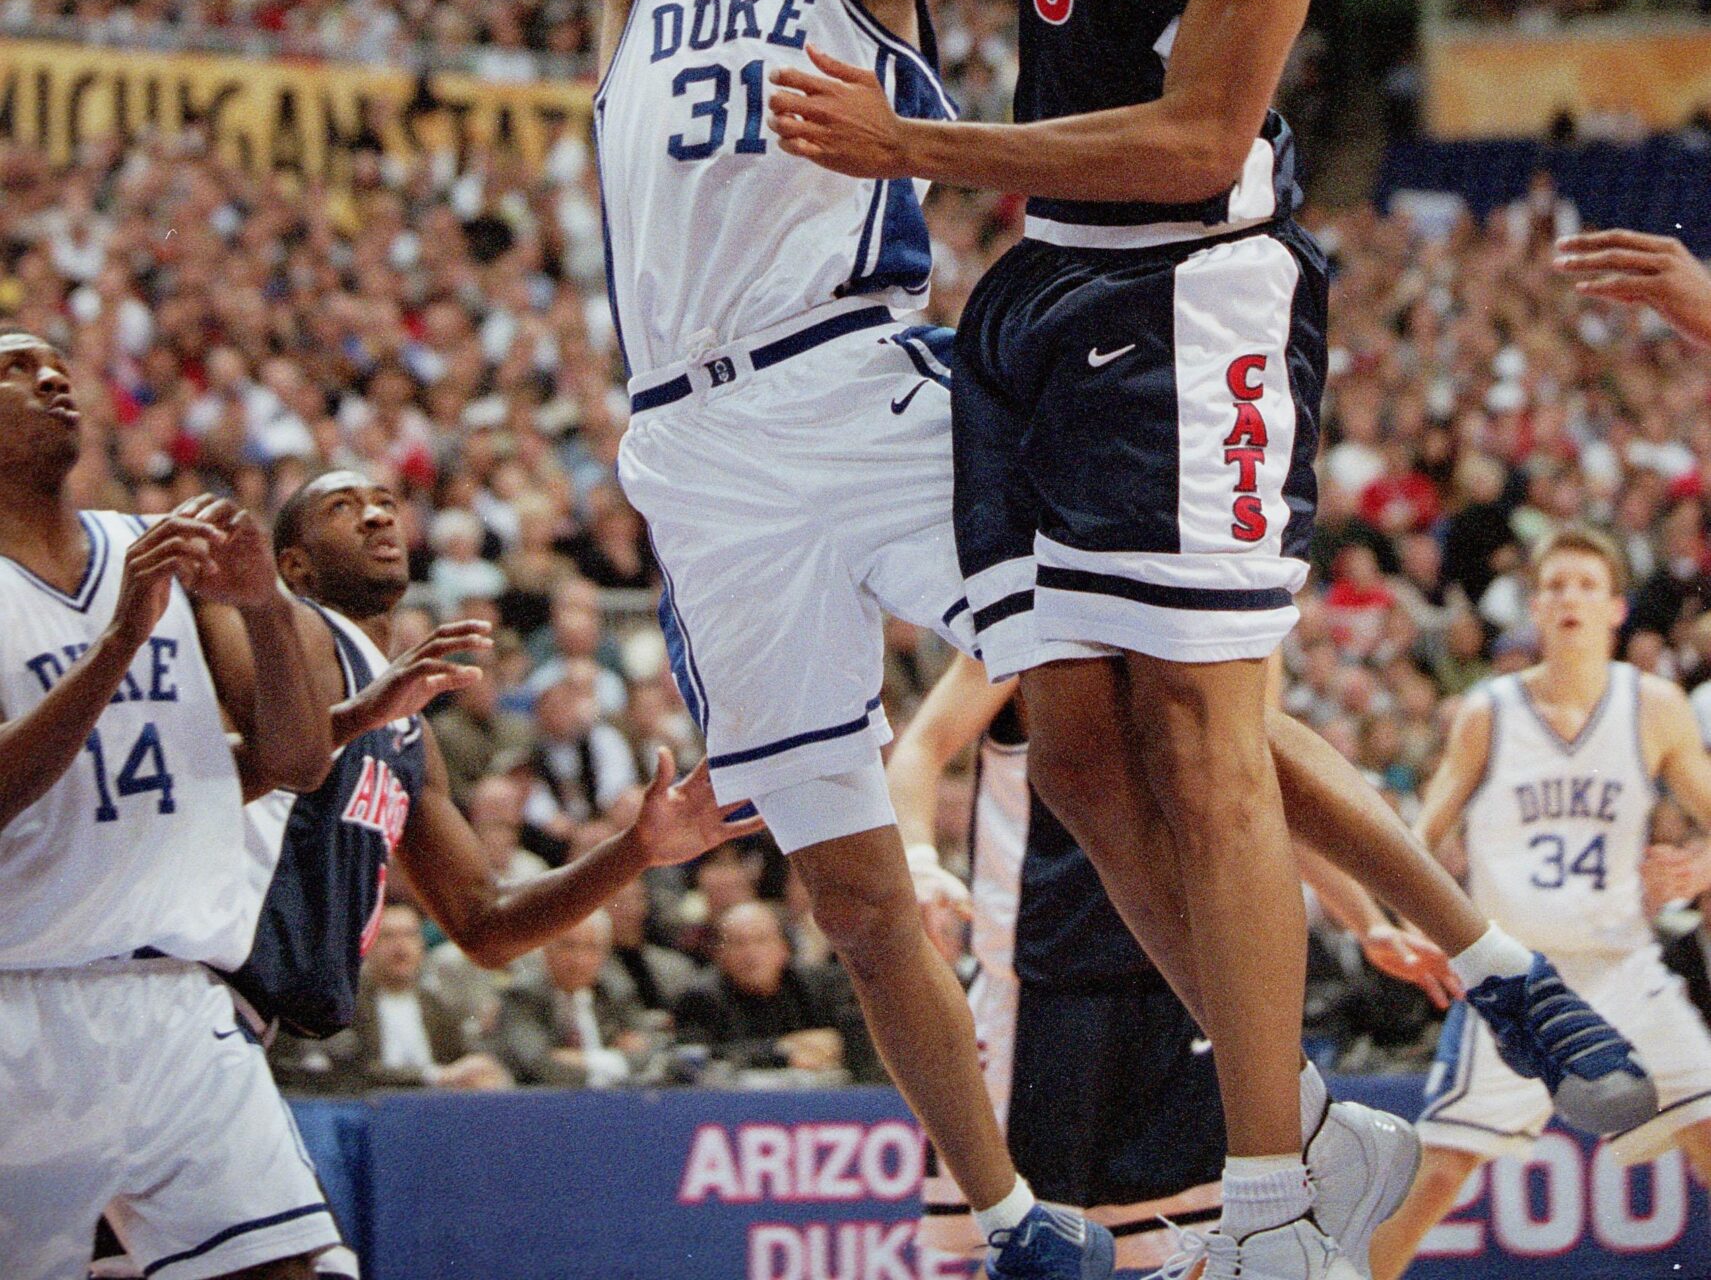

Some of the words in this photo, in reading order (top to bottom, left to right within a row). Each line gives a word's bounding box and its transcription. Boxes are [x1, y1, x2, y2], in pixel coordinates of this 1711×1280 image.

[667, 59, 768, 162] 31
[1223, 354, 1269, 542] CATS
[26, 636, 178, 704] DE
[85, 722, 176, 822] 14
[1514, 777, 1623, 824] DUKE
[1528, 832, 1607, 891] 34
[677, 1120, 928, 1204] ARIZO
